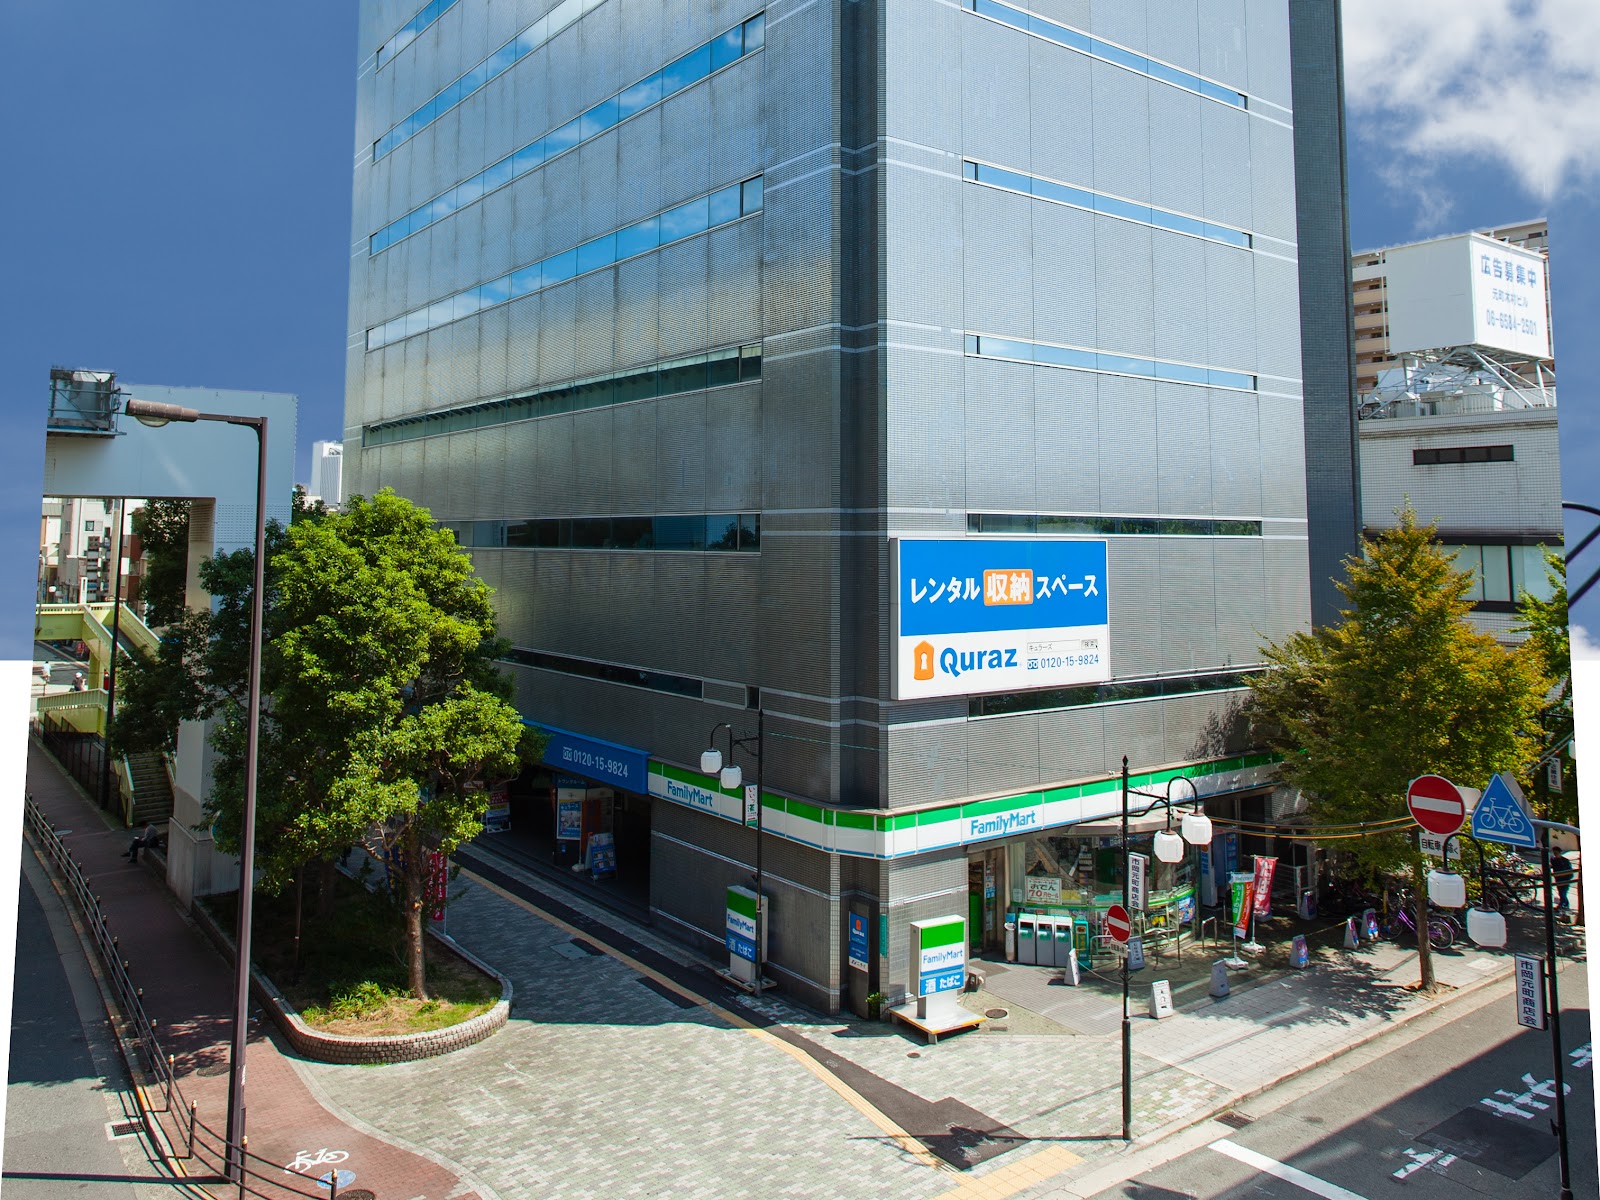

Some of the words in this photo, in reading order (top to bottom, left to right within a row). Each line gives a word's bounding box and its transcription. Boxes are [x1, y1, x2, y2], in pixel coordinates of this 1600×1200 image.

[1481, 254, 1537, 288] 広告募集中
[940, 647, 1018, 678] Quraz
[1040, 654, 1099, 669] 0120-15-9824
[573, 750, 628, 778] 0120-15-9824
[667, 780, 713, 807] FamilyMart
[970, 810, 1036, 836] FamilyMart
[727, 914, 754, 933] FamilyMart
[738, 943, 753, 958] たばこ
[923, 949, 964, 964] FamilyMart
[925, 978, 936, 993] 酒
[939, 974, 961, 989] たばこ
[1520, 960, 1537, 1027] 市岡元町商店会
